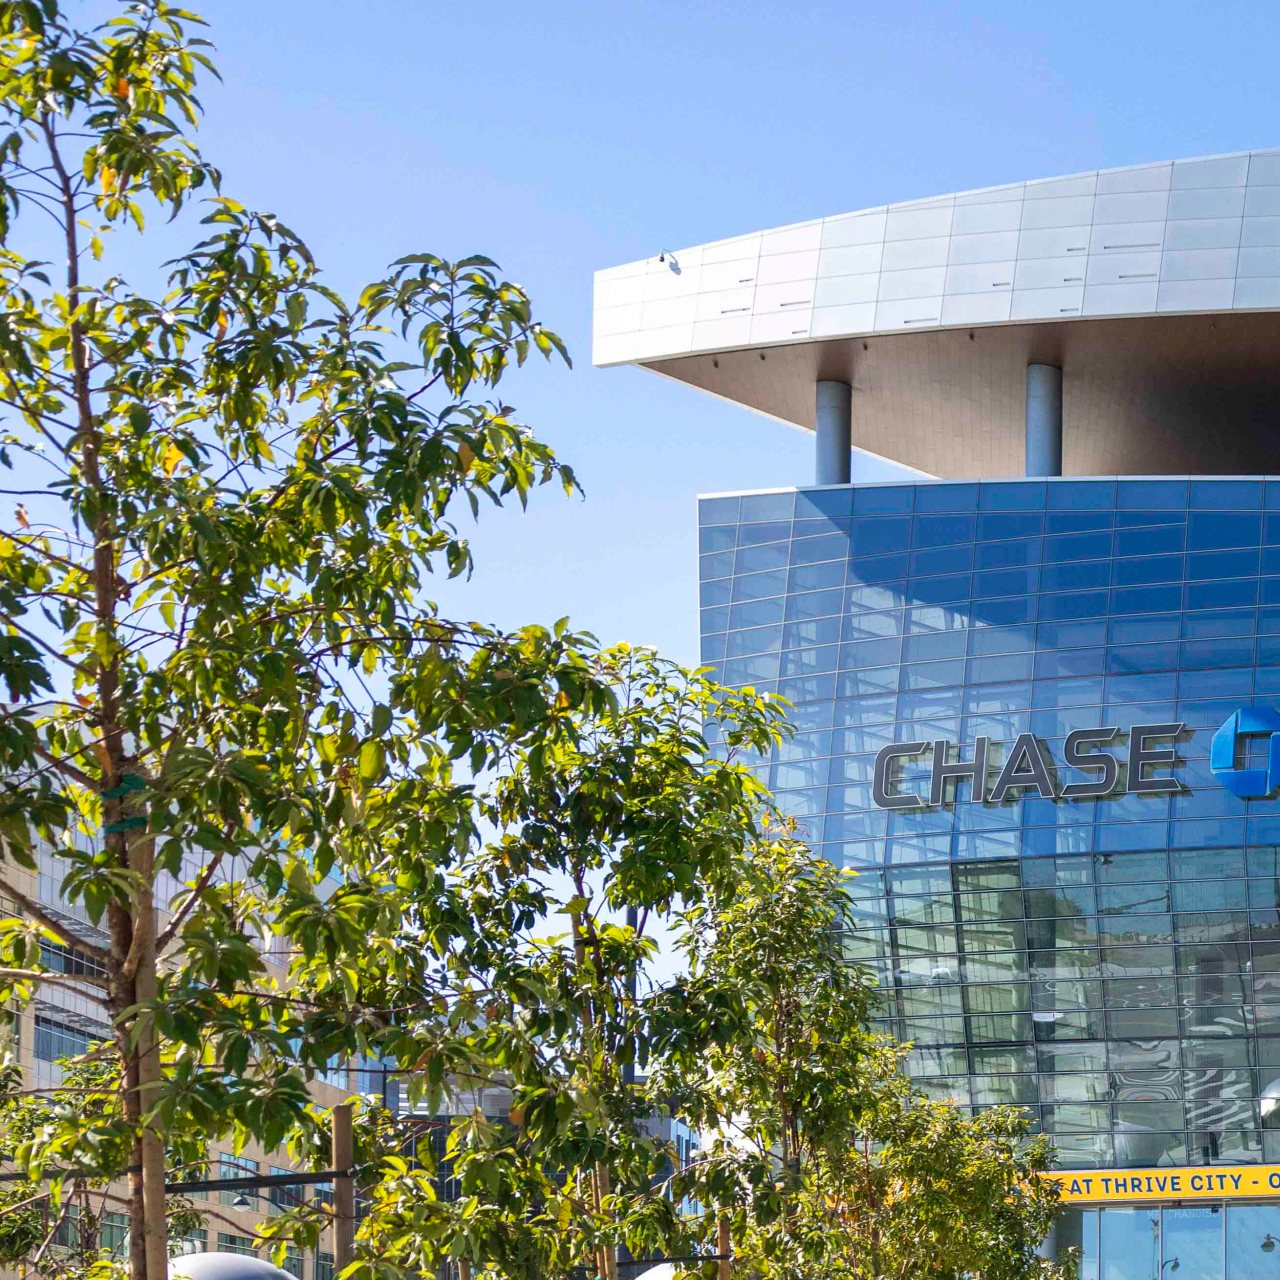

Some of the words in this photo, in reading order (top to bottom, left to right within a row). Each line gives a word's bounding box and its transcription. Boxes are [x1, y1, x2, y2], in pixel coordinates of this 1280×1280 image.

[873, 722, 1185, 809] CHASE
[1070, 1179, 1093, 1194] AT
[1101, 1175, 1182, 1193] THRIVE
[1190, 1173, 1243, 1191] CITY
